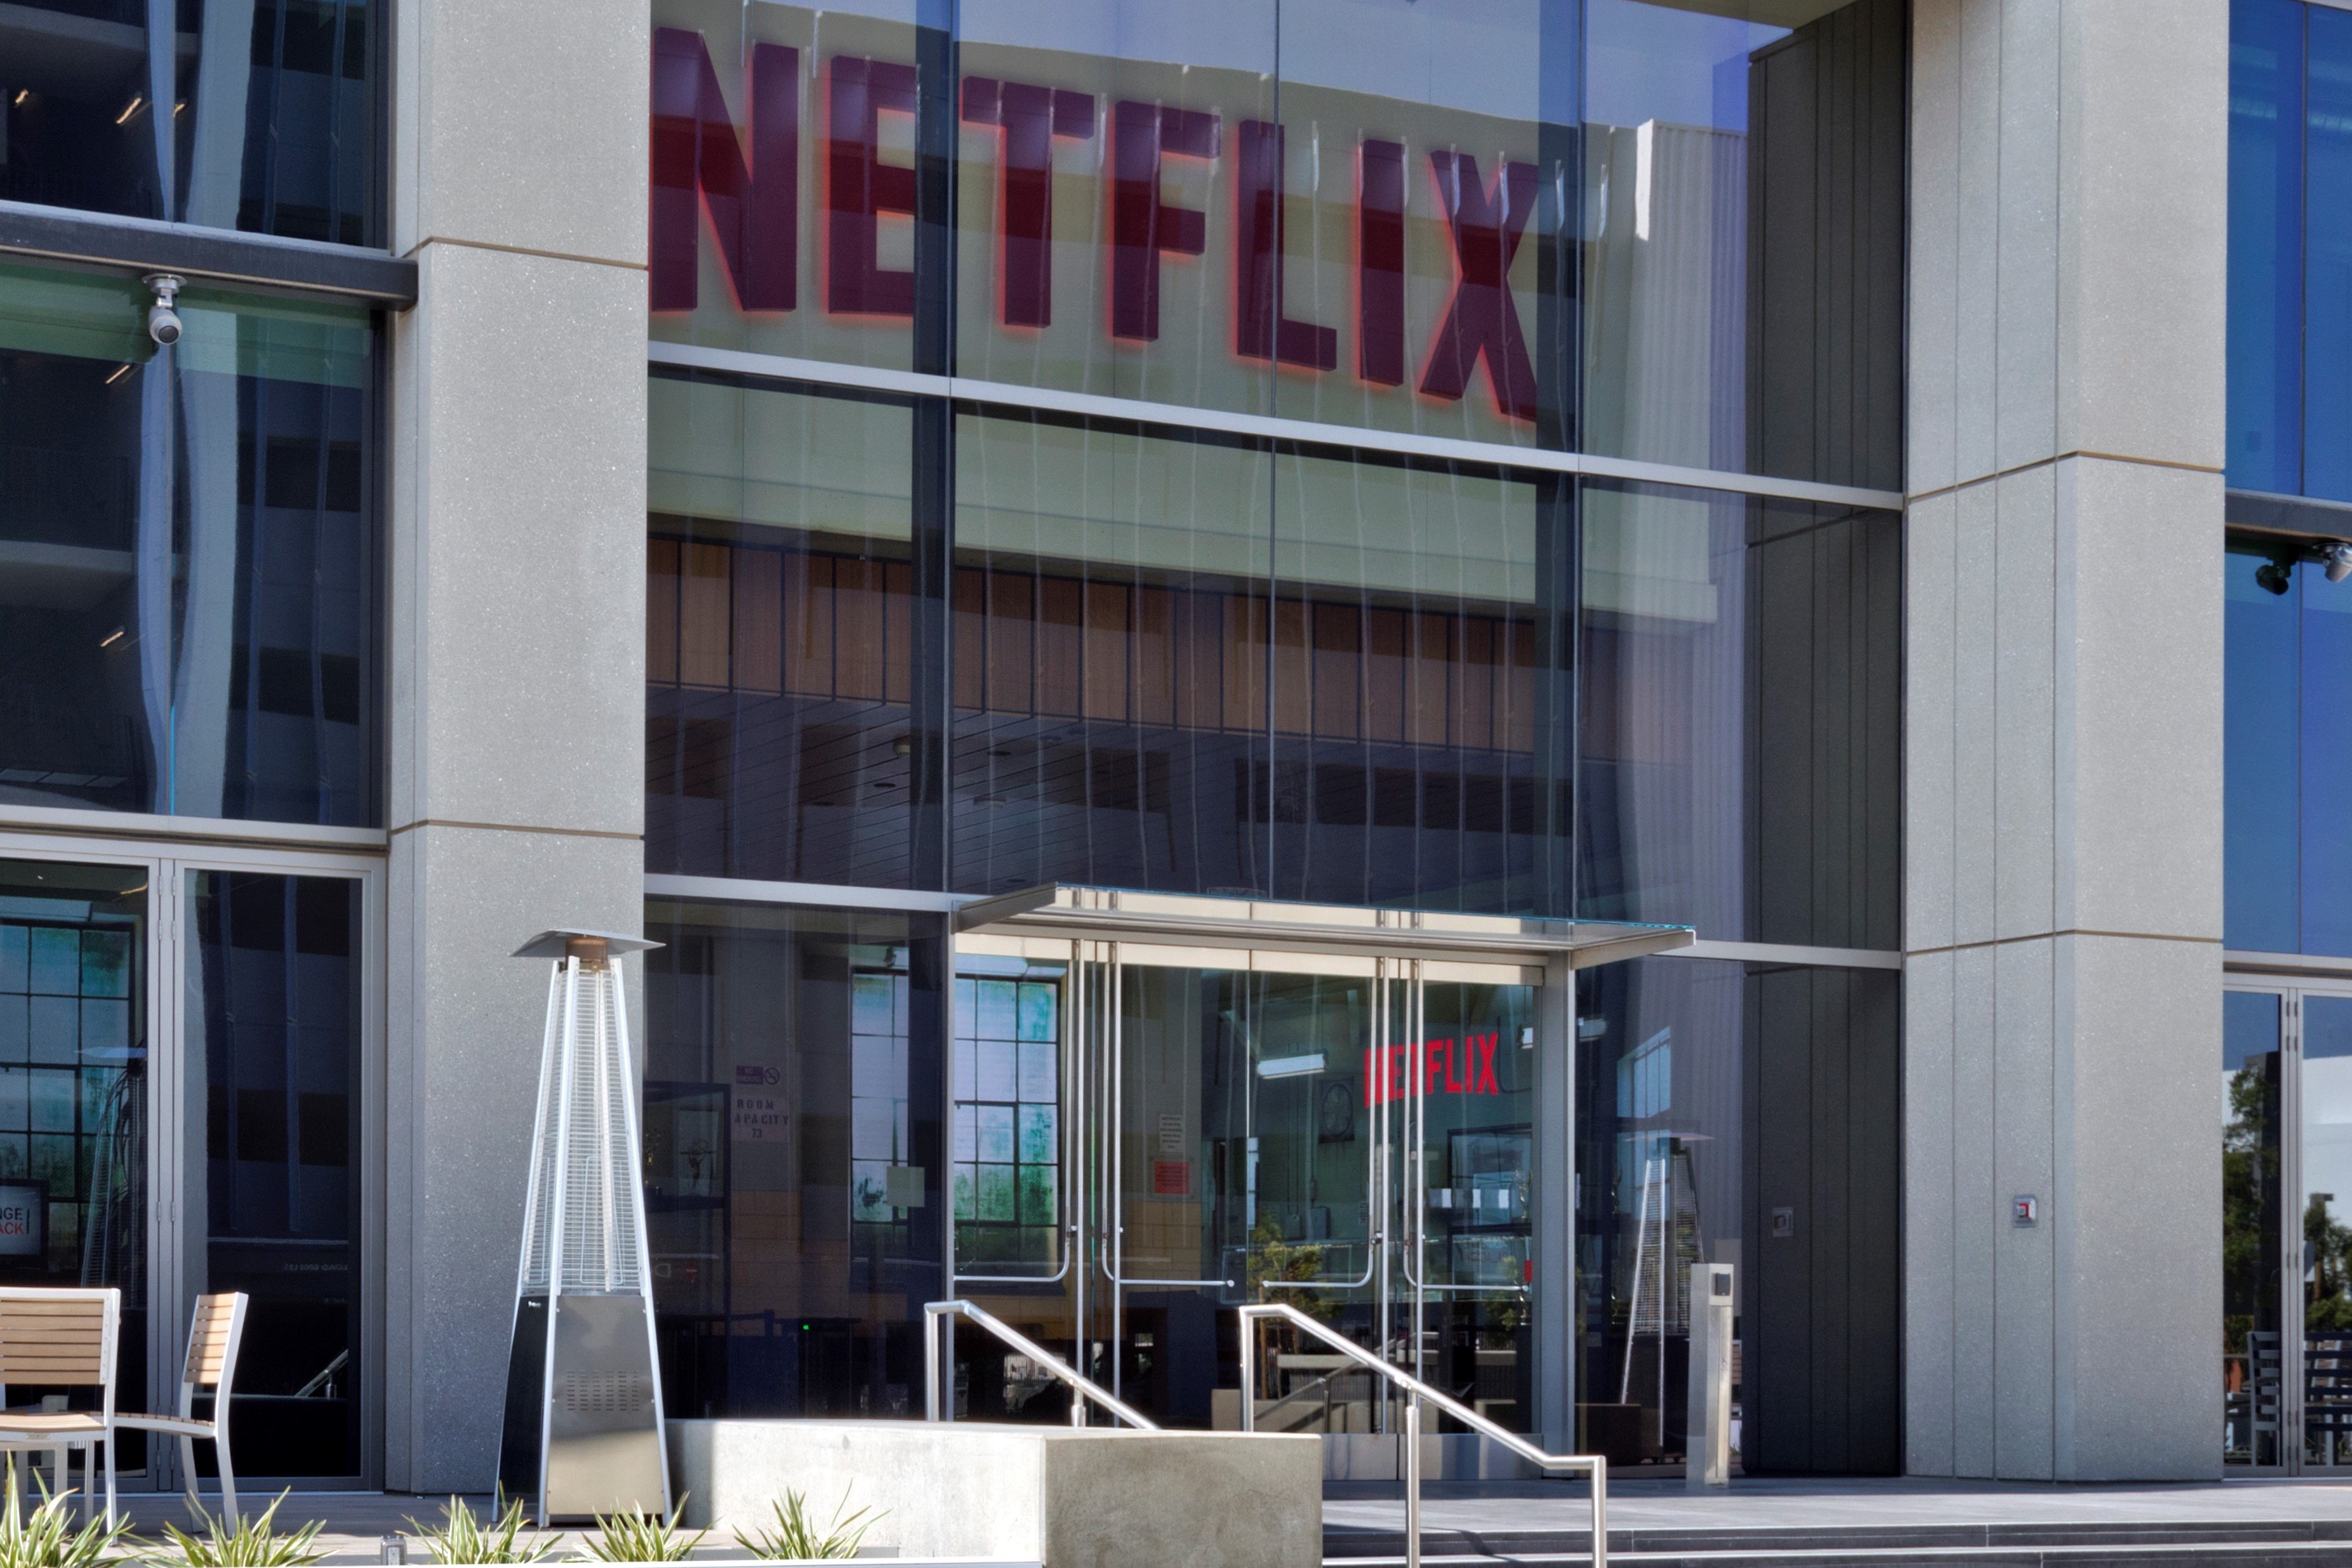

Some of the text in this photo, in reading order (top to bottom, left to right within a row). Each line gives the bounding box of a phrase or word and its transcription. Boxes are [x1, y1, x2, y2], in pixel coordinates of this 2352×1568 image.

[651, 27, 1538, 422] NETFLIX
[738, 1100, 773, 1109] ROOM
[735, 1114, 788, 1124] APACITY
[752, 1129, 762, 1138] 73
[0, 1207, 23, 1220] GE
